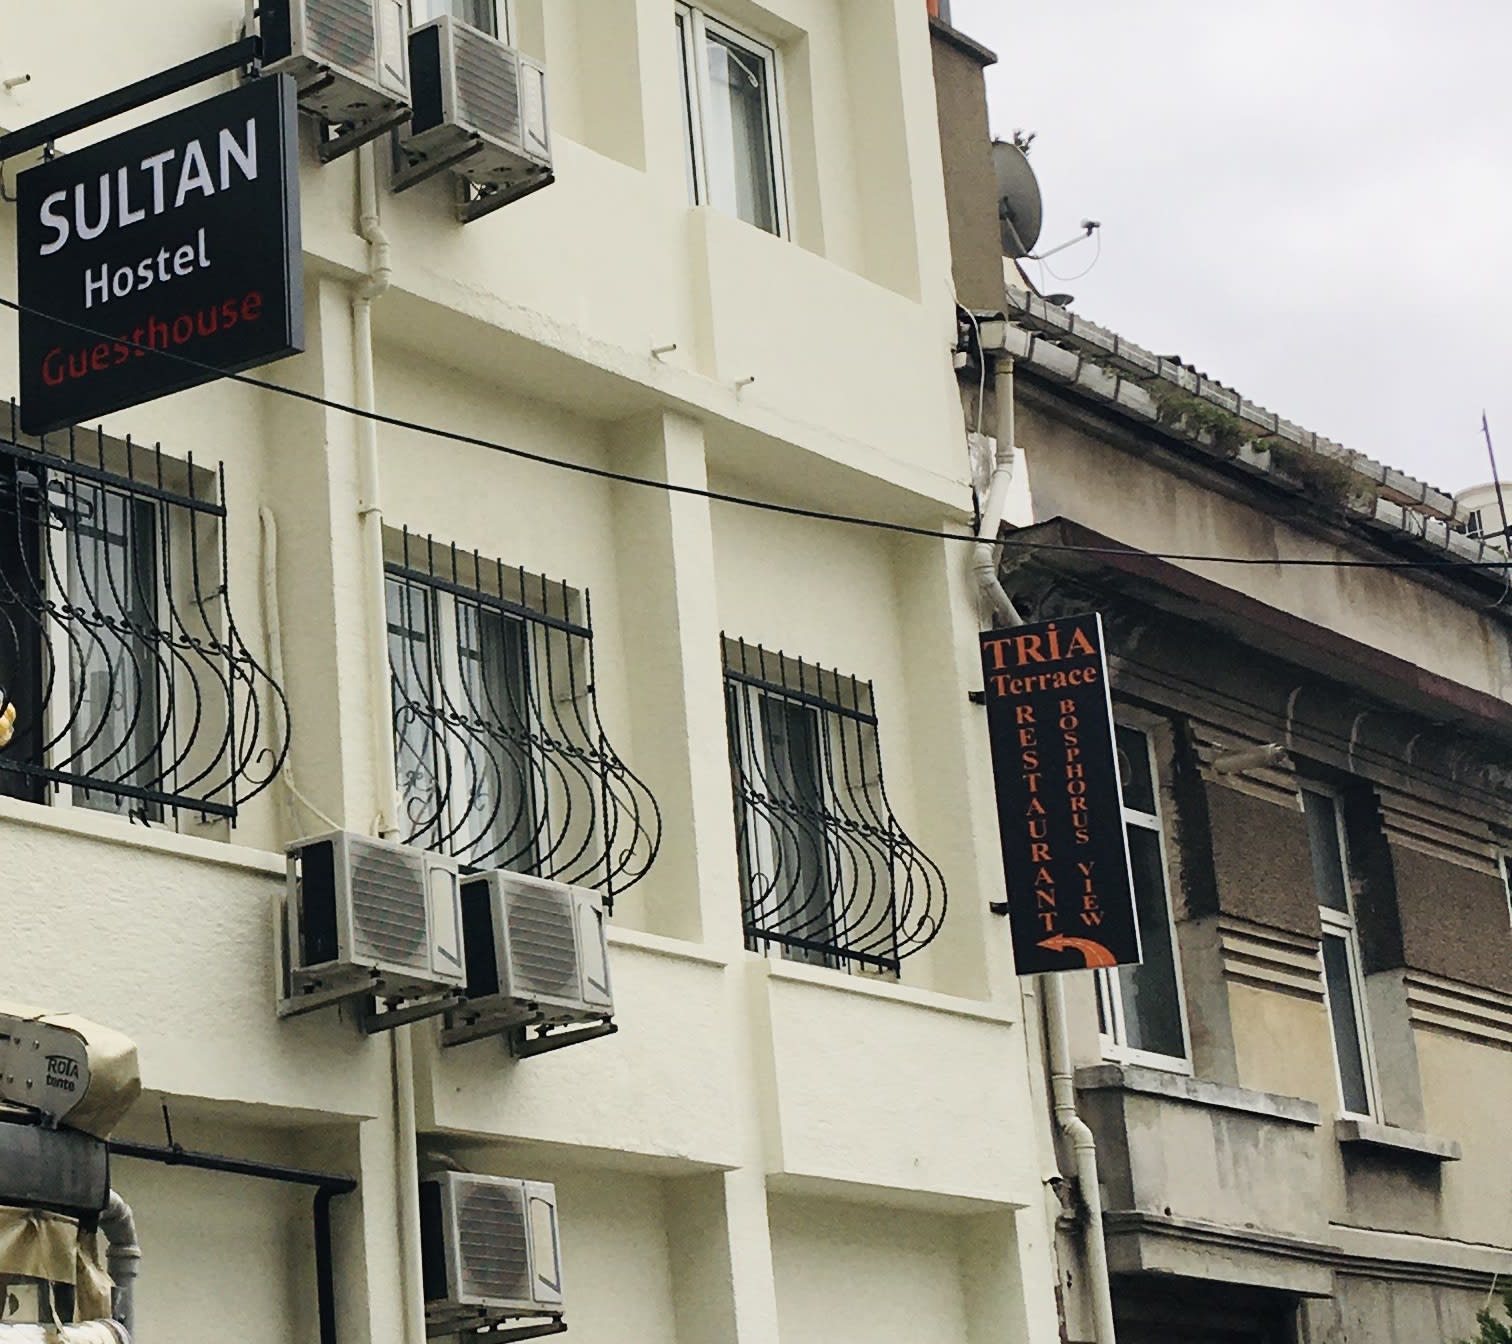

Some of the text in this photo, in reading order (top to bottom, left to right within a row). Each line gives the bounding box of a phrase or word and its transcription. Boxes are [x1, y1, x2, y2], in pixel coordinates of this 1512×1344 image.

[39, 118, 258, 255] SULTAN
[85, 228, 211, 308] Hostel
[41, 290, 263, 386] Guesthouse
[990, 664, 1097, 698] Terrace
[1016, 704, 1057, 932] RESTAURANT
[1059, 699, 1105, 927] BOSPHORUS VIEW
[45, 1055, 79, 1080] ROTA
